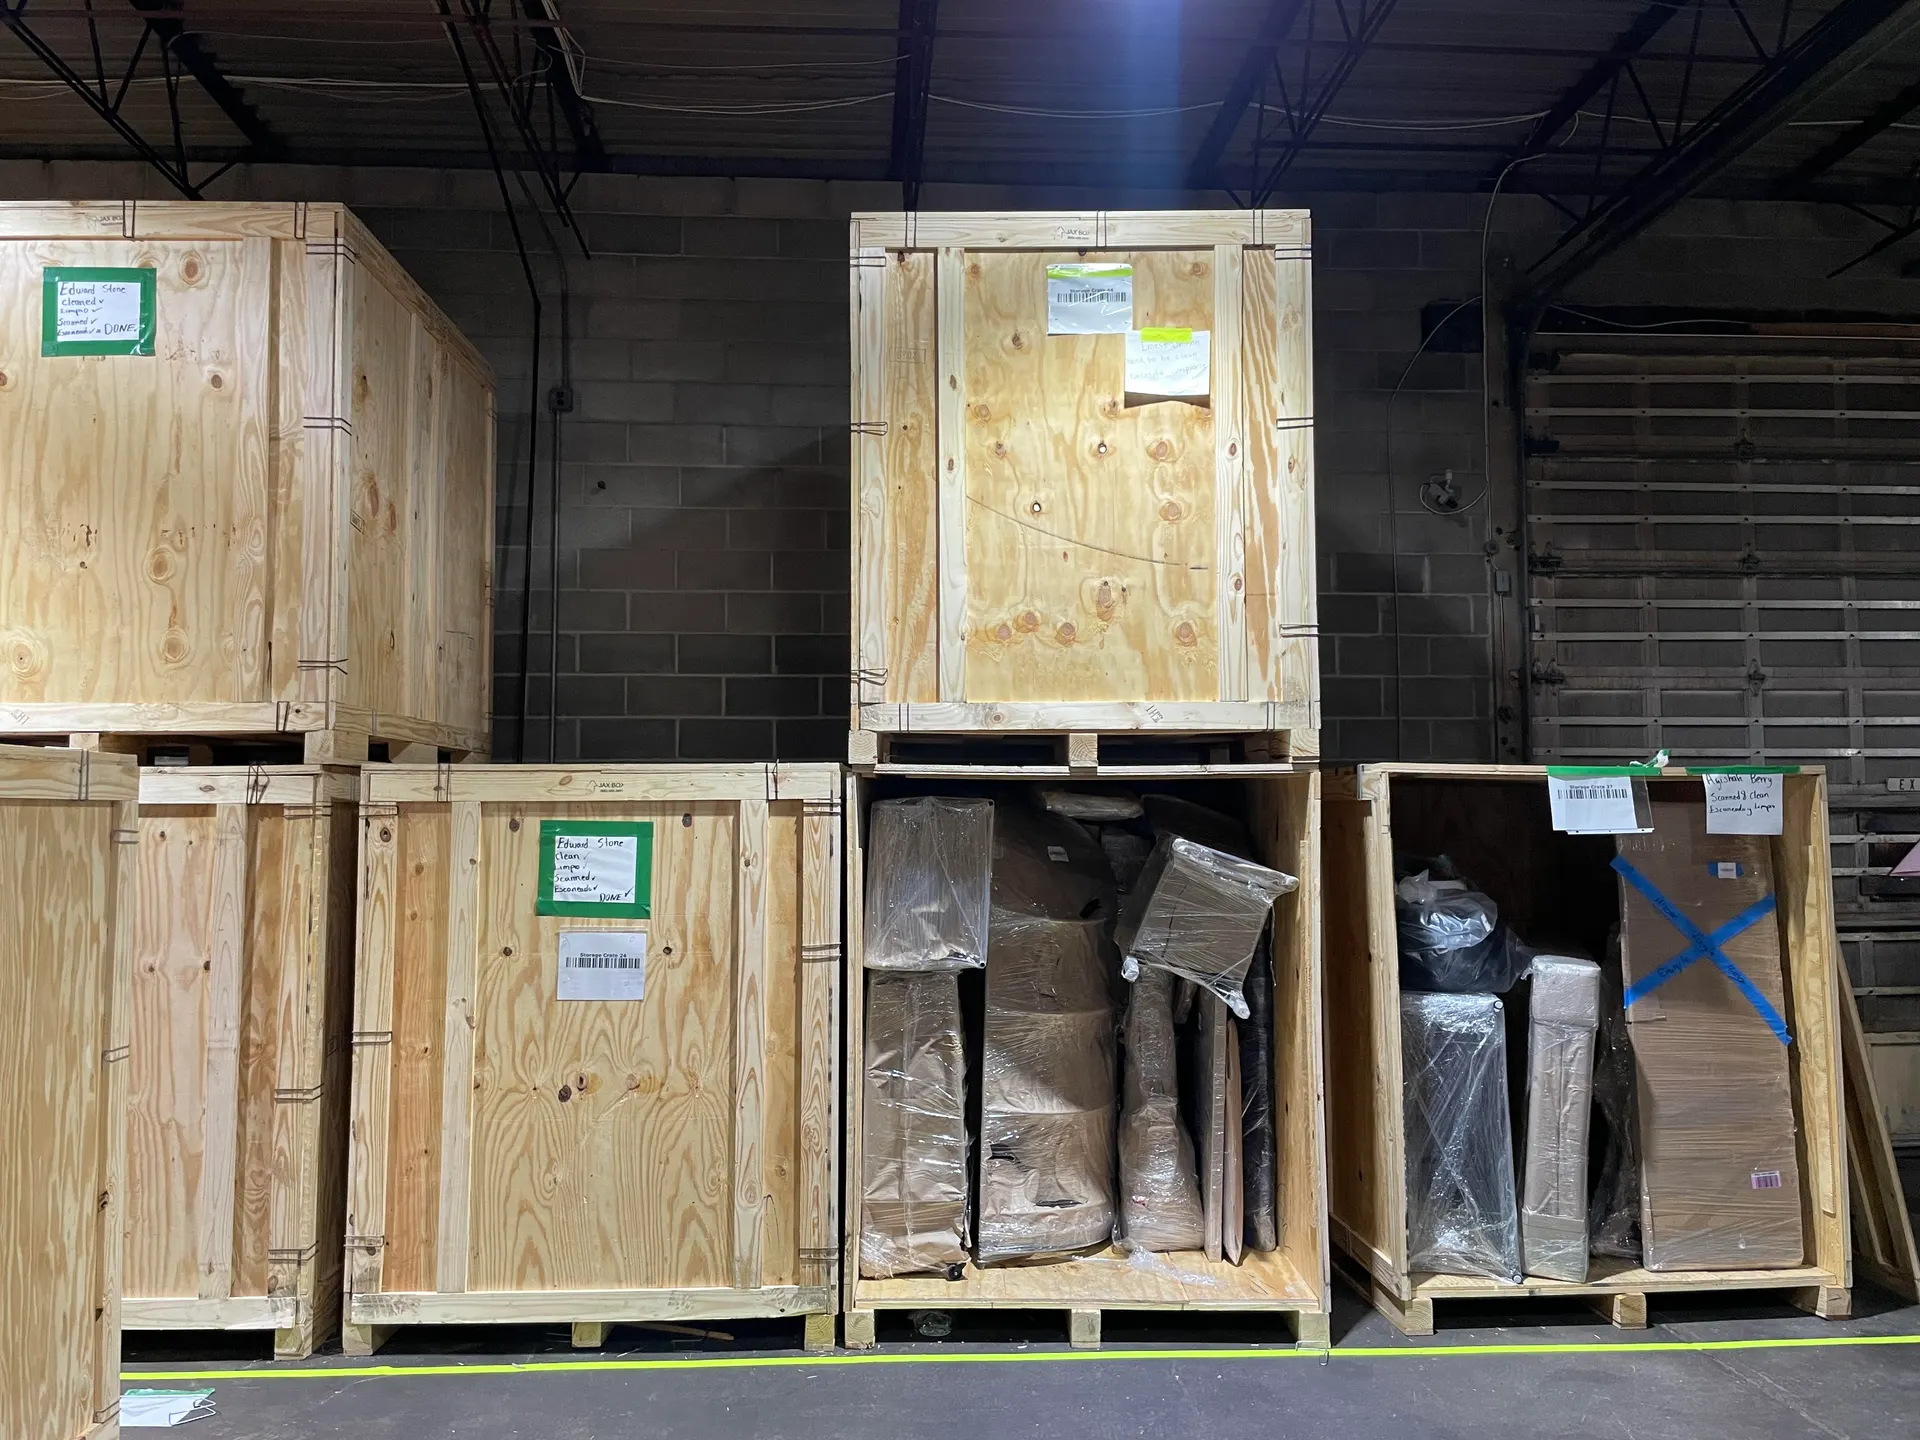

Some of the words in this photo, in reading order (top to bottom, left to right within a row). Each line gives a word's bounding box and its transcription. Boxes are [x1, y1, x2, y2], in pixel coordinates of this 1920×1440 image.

[60, 283, 95, 296] Edward
[557, 837, 589, 849] Edward
[597, 837, 624, 848] Stone
